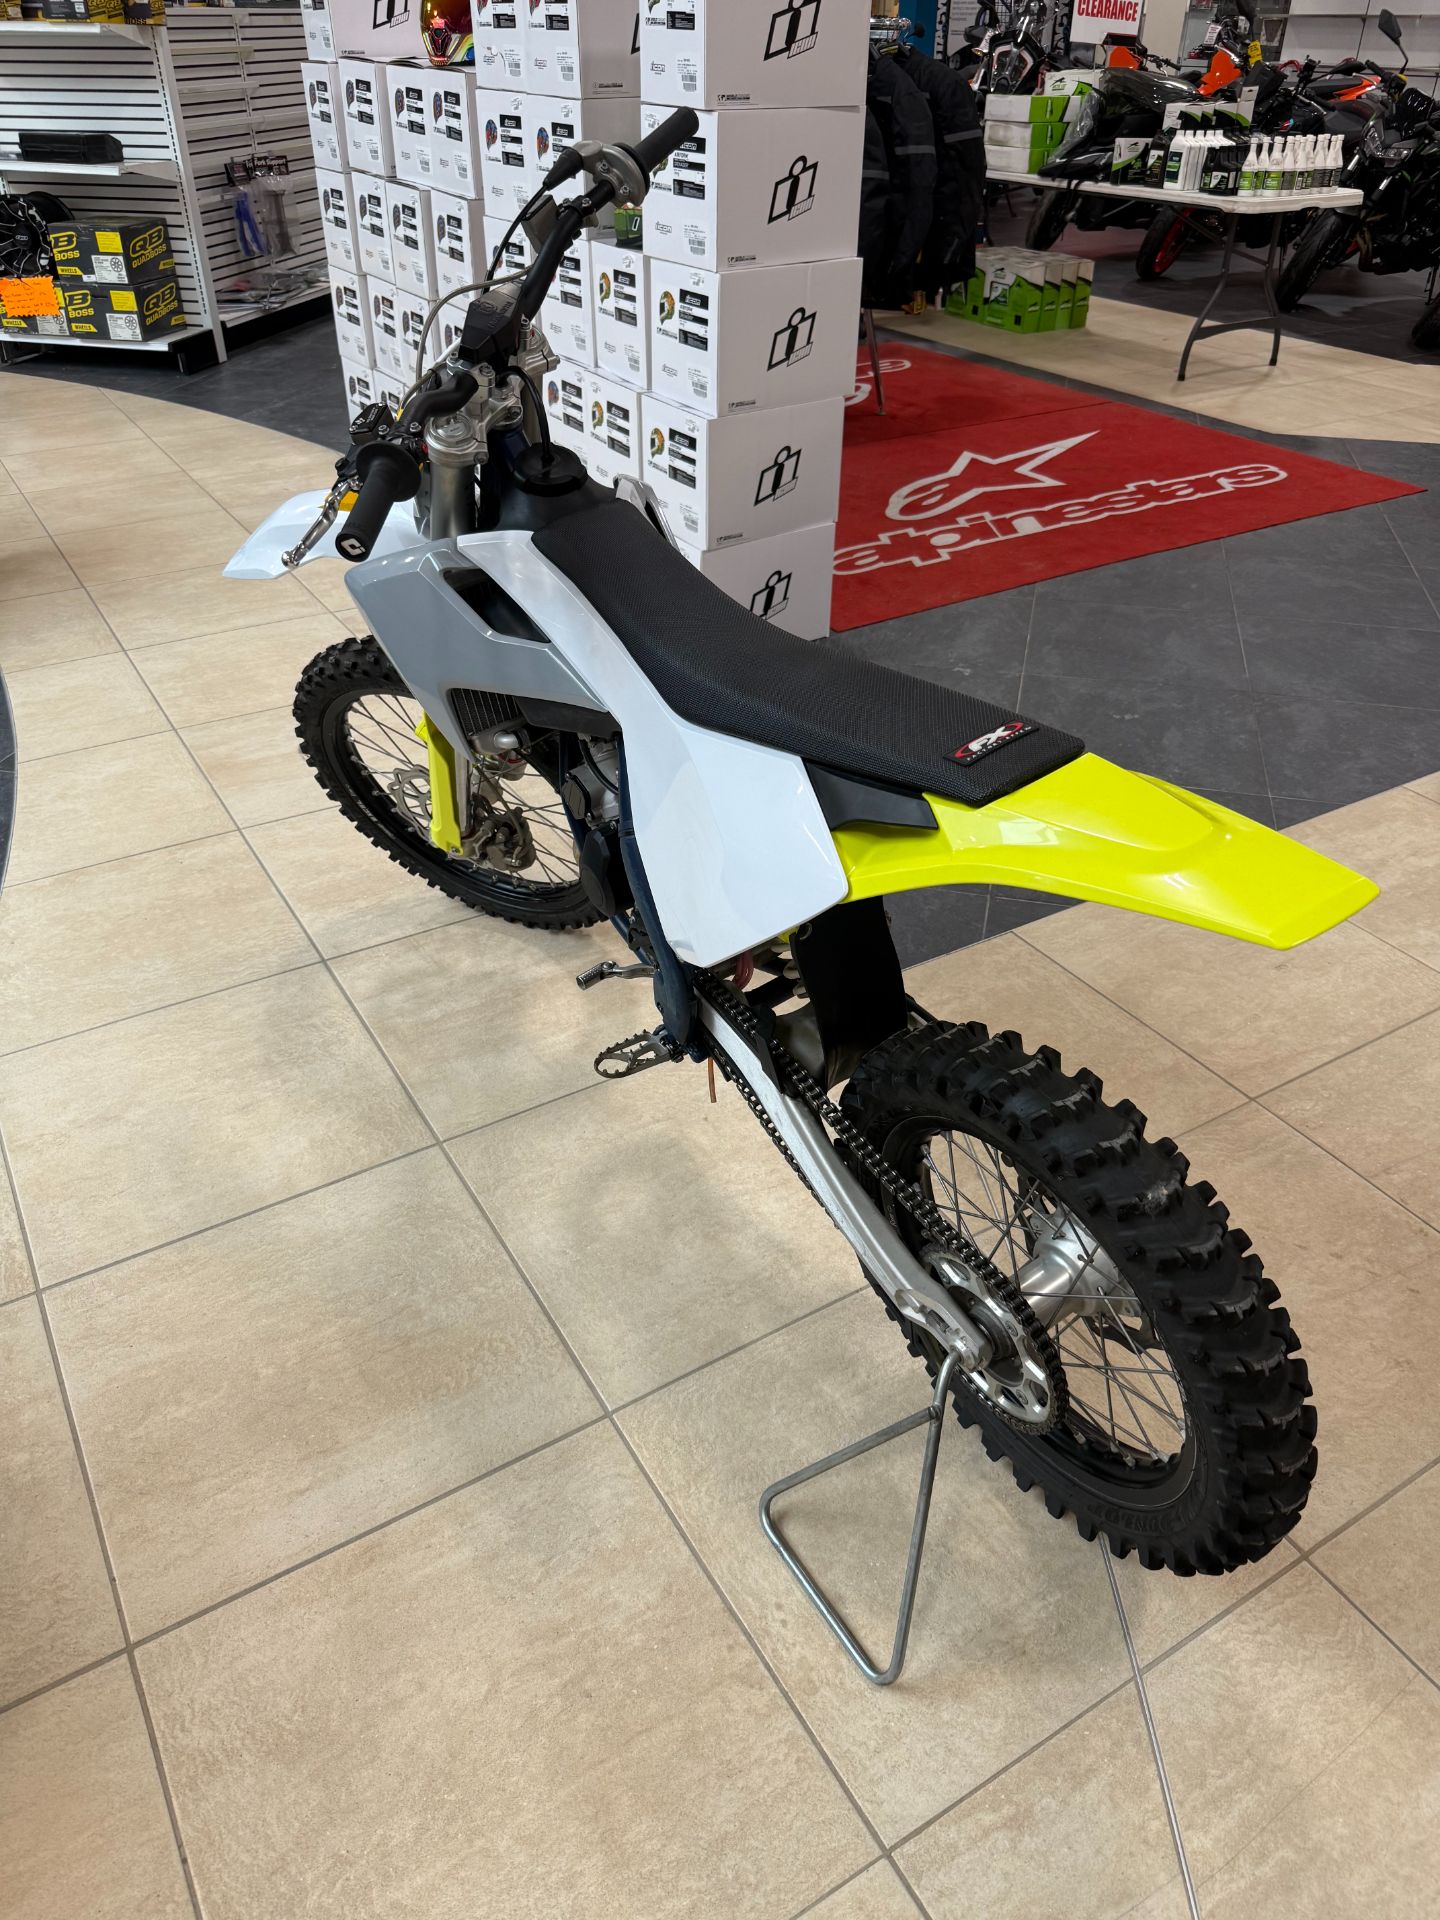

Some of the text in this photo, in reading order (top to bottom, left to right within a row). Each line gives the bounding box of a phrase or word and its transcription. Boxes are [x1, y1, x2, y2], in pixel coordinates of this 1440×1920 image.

[1077, 0, 1139, 22] CLEARANCE
[132, 243, 167, 268] QUADBOSS
[145, 299, 178, 326] QUADBOSS
